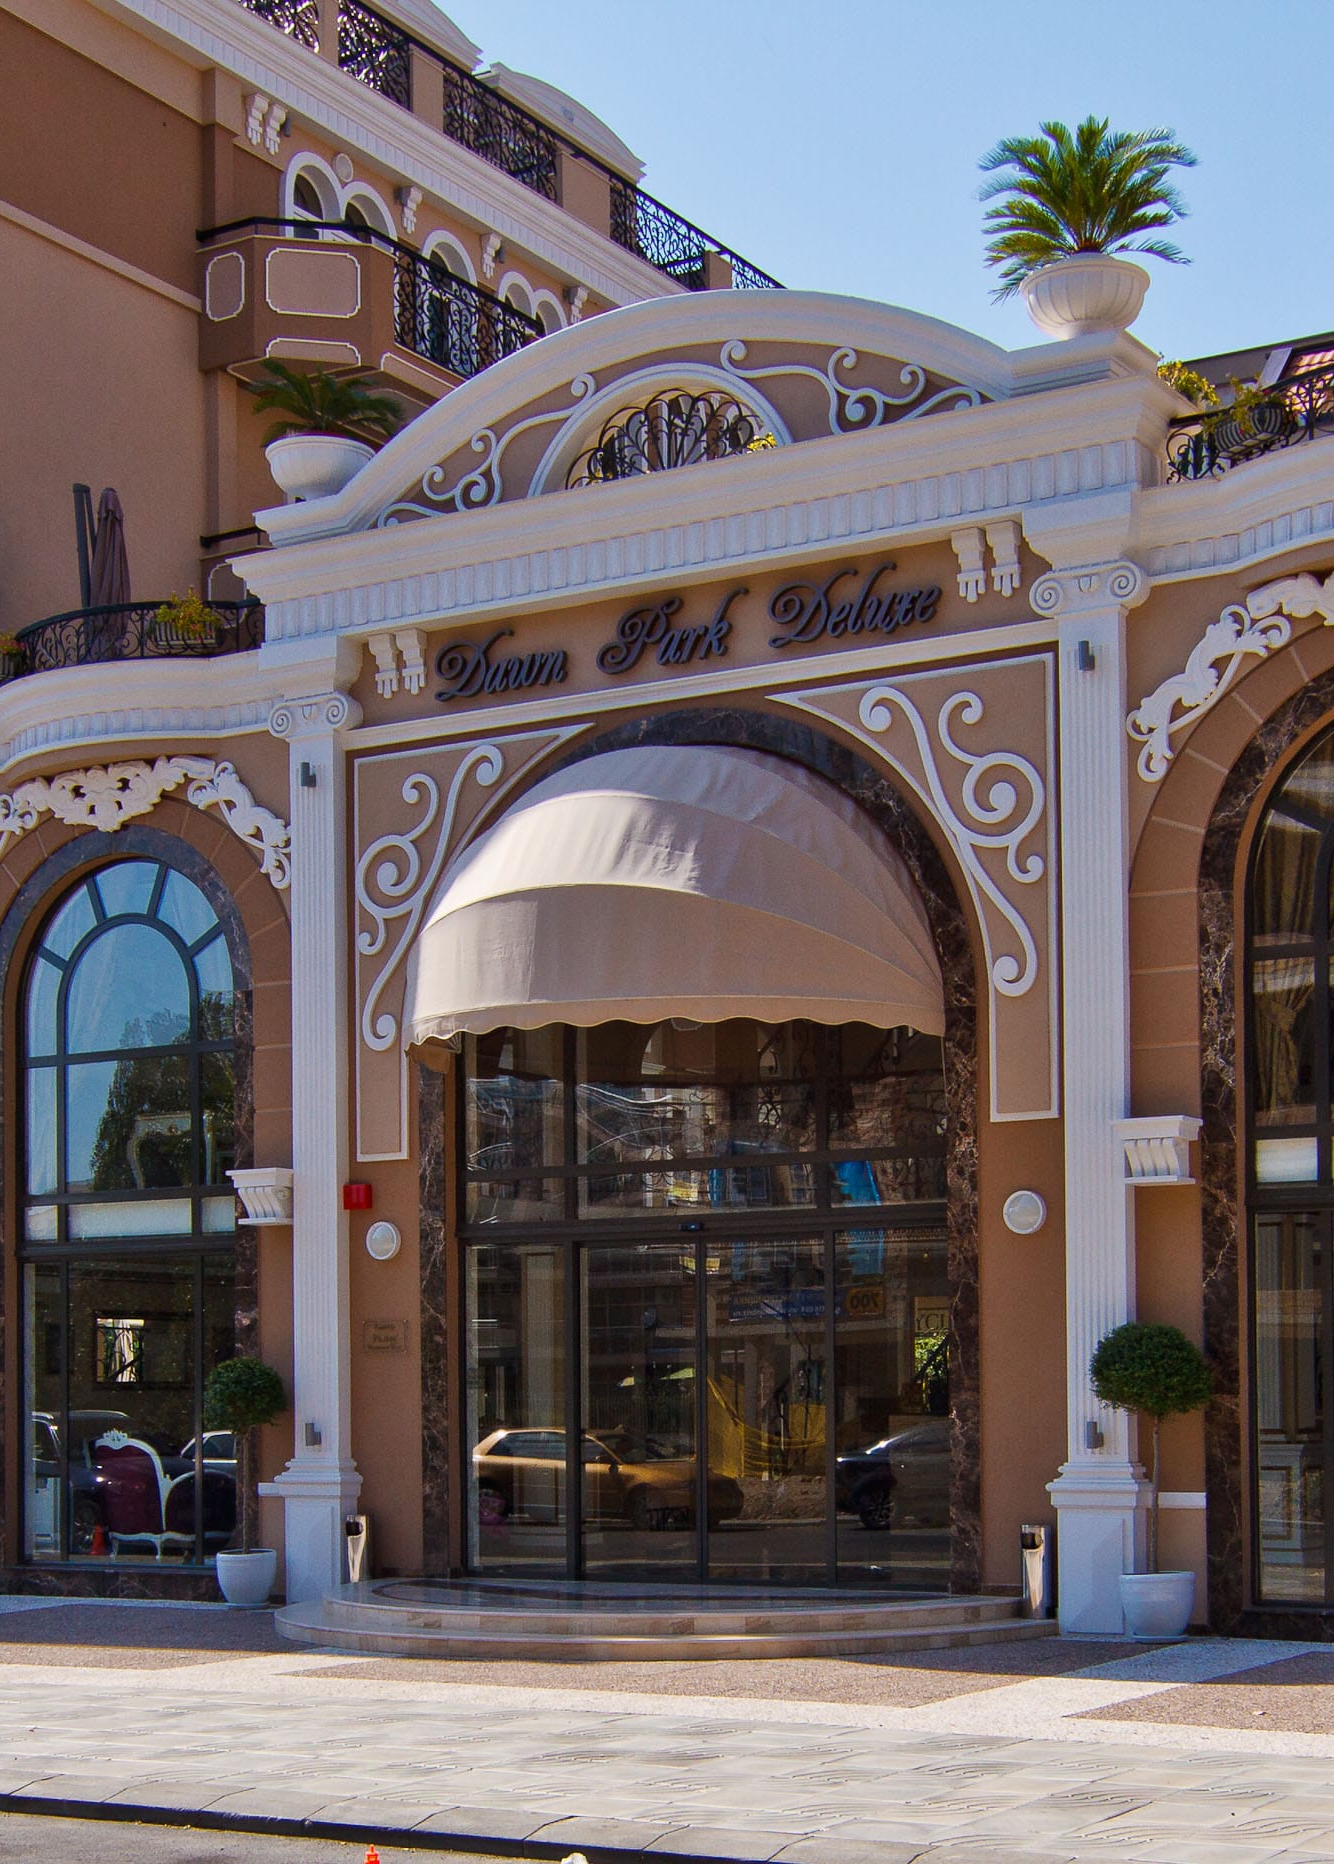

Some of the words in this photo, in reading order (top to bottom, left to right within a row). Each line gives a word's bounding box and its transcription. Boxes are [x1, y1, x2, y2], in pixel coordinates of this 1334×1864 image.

[434, 628, 568, 702] Dawn
[596, 586, 750, 676] Park
[767, 560, 943, 650] Deluxe
